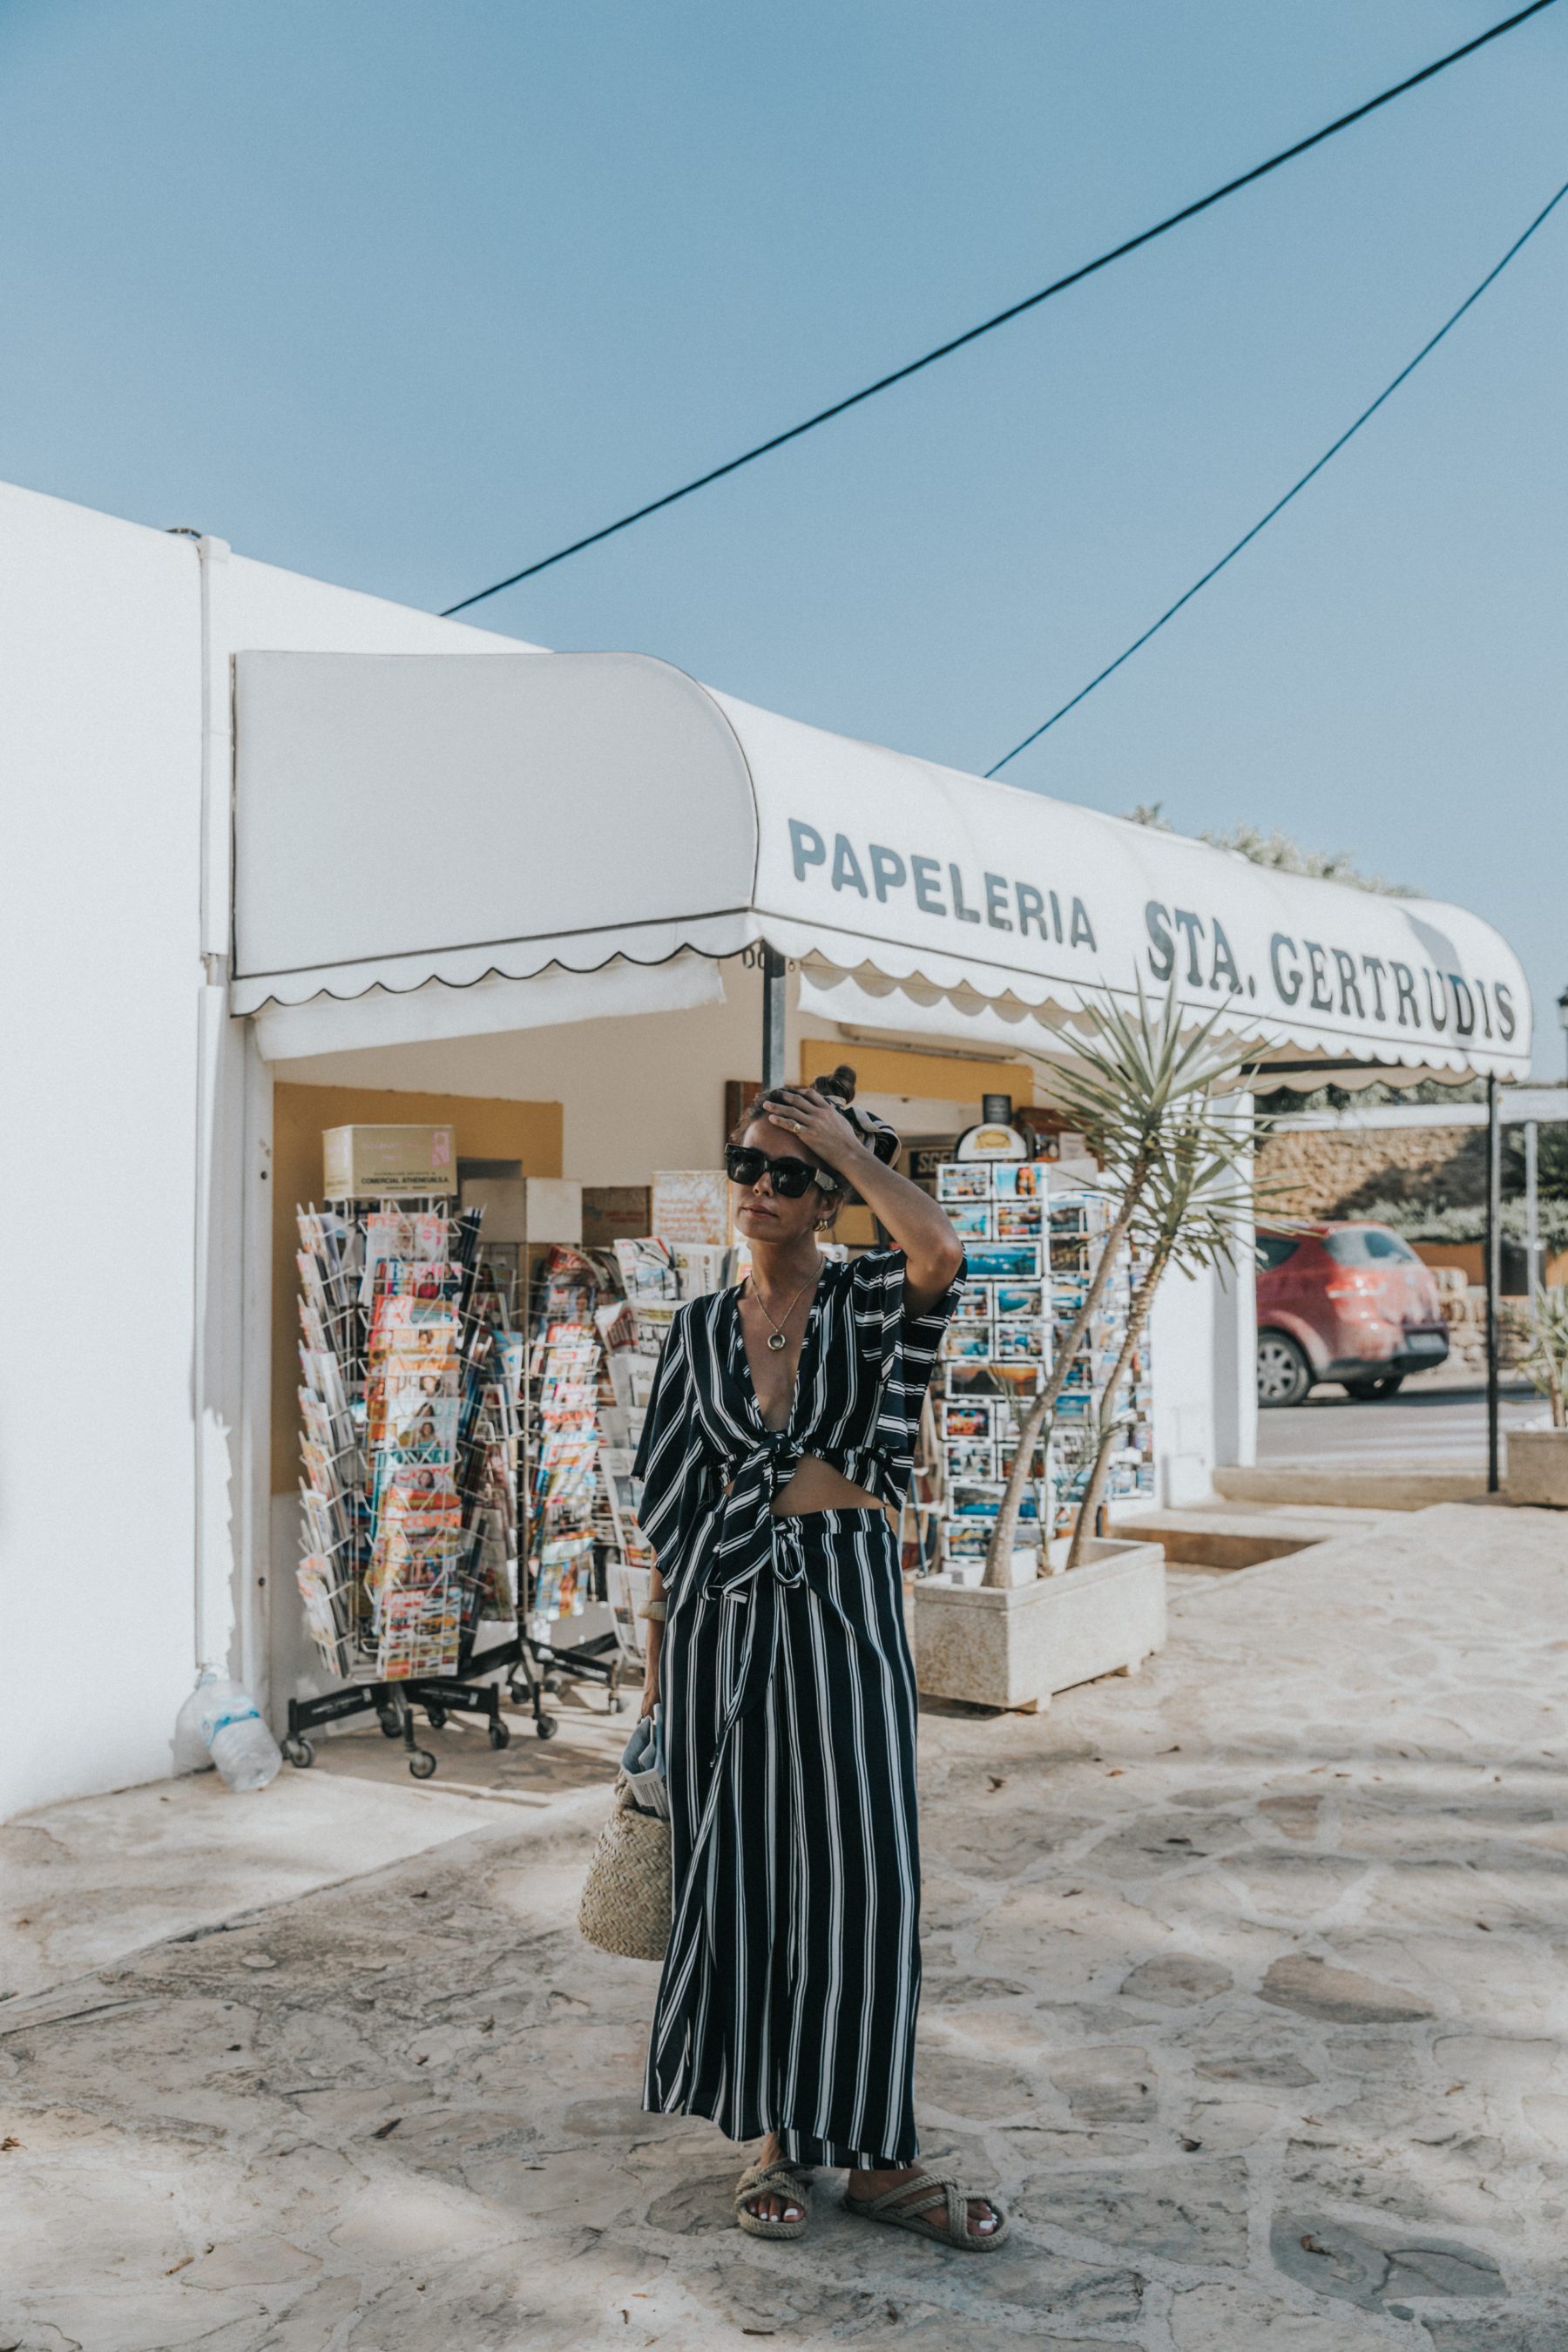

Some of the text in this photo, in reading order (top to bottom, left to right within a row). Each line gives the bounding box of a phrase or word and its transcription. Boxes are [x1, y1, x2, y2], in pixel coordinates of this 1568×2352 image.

[787, 818, 1517, 1042] PAPELERIA STA. GERTRUDIS
